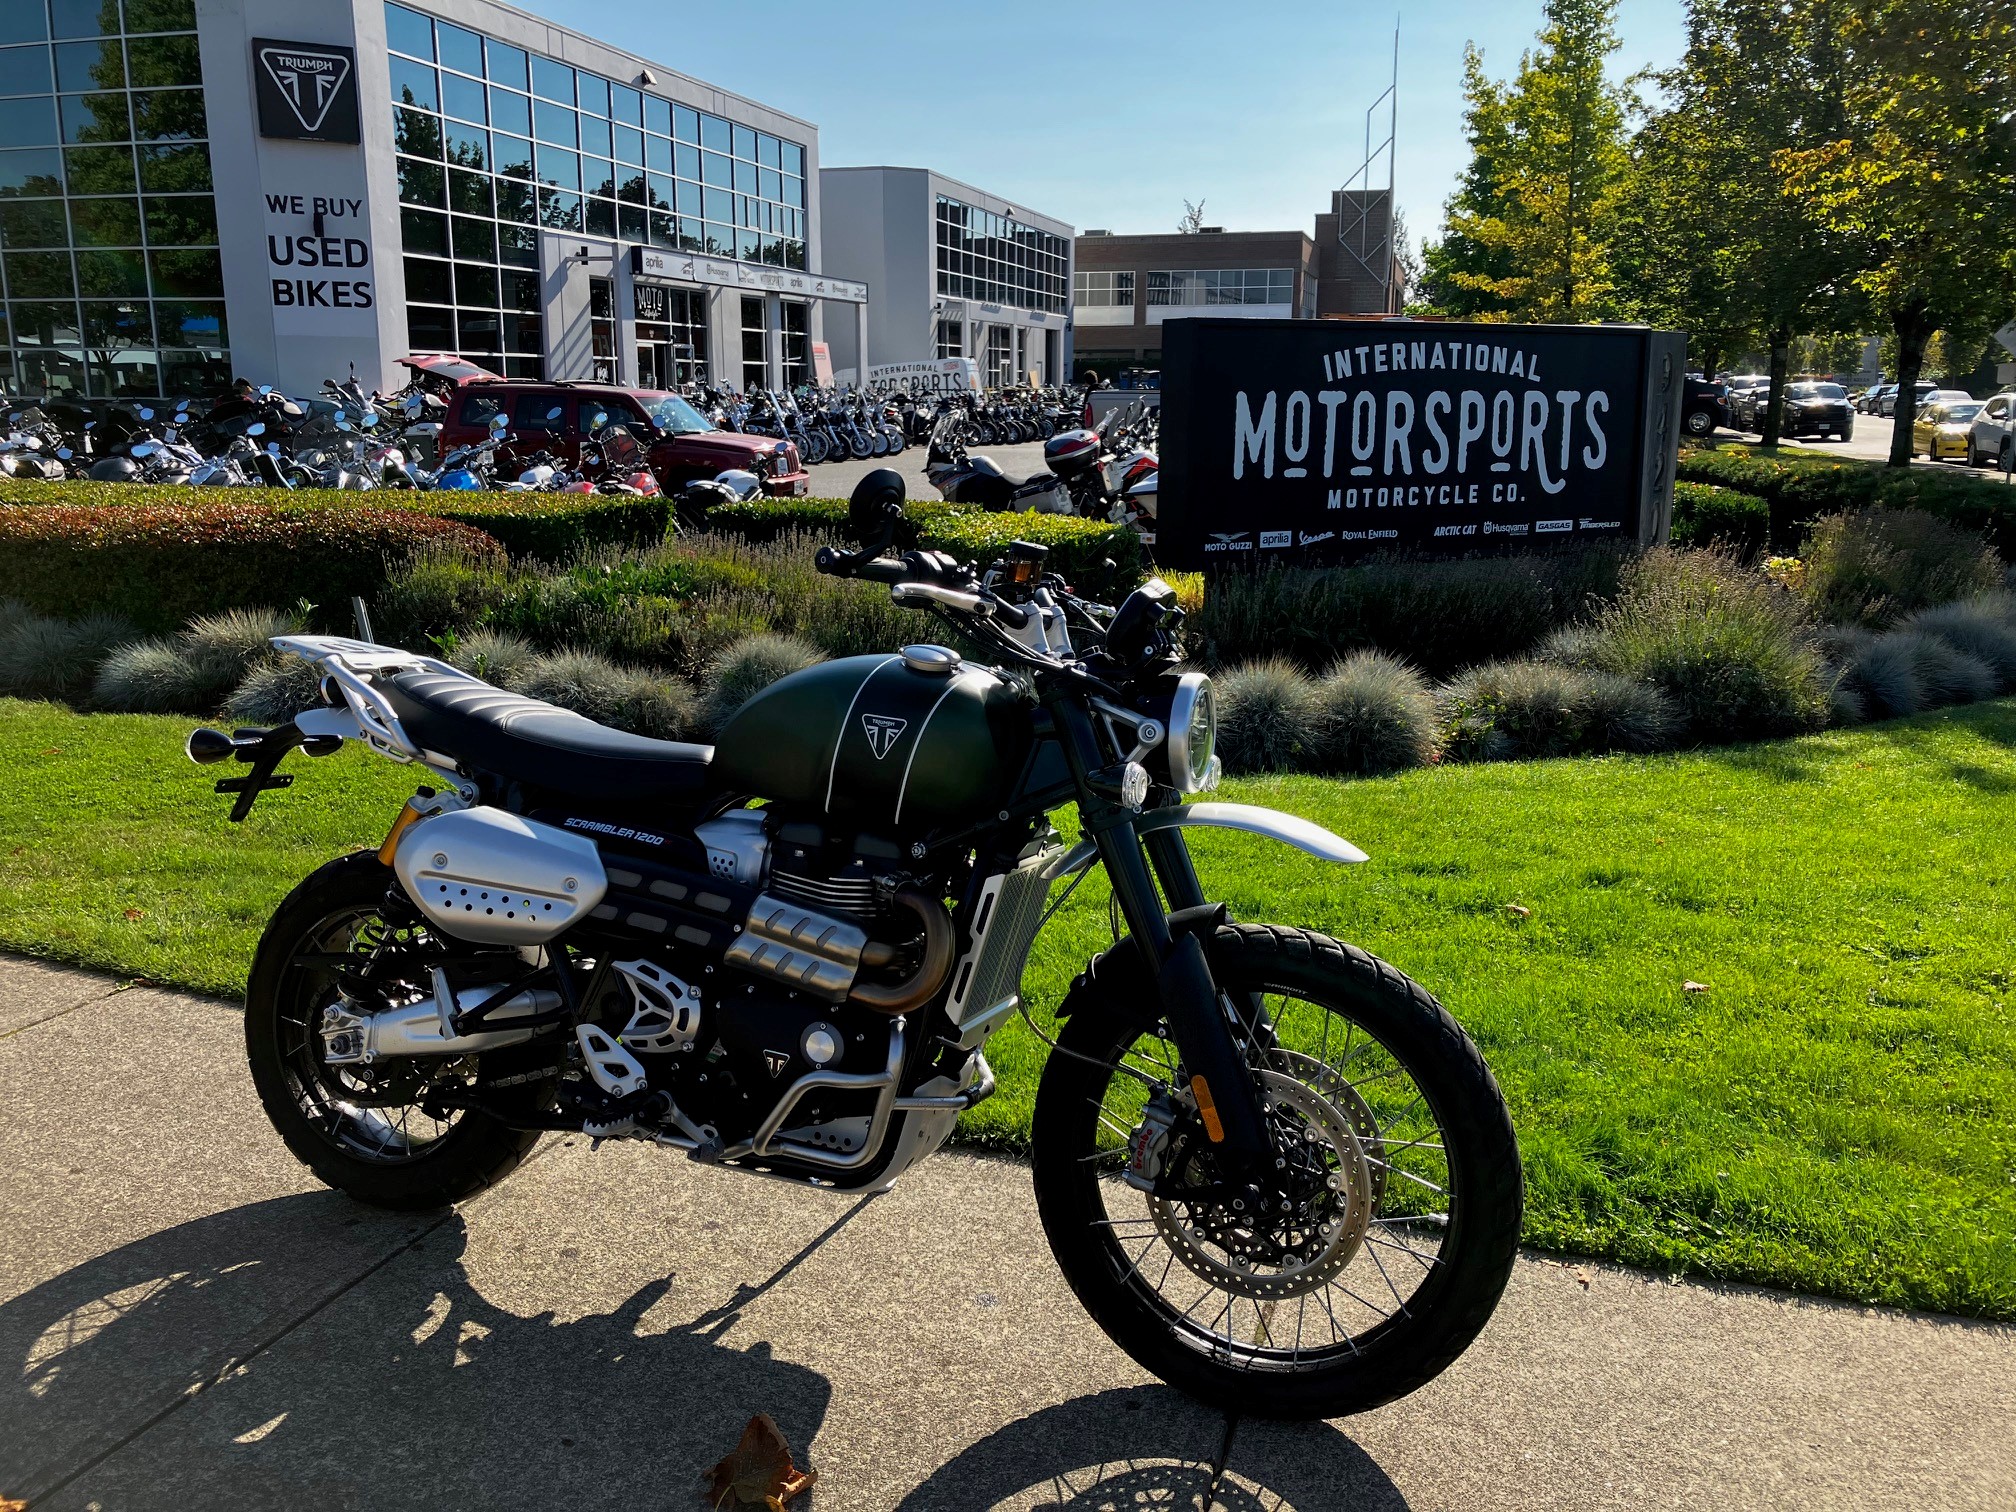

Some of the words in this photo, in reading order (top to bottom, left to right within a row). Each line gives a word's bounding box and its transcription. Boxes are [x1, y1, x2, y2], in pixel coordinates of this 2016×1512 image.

[277, 56, 333, 72] TRIUMPH
[265, 194, 305, 215] WE
[313, 197, 363, 218] BUY
[268, 235, 369, 268] USED
[272, 279, 373, 309] BIKES
[636, 286, 663, 311] MOTO
[1323, 342, 1541, 382] INTERNATIONAL
[870, 364, 939, 378] INTERNATIONAL
[1233, 390, 1610, 494] MOTORSPORTS
[1327, 484, 1478, 509] MOTORCYCLE
[1492, 483, 1526, 502] CO.
[1433, 526, 1461, 536] ARCTIC
[1462, 524, 1478, 535] CAT
[1492, 522, 1529, 534] Husqvarna
[1538, 521, 1571, 530] GASGAS
[1262, 533, 1290, 546] aprilia
[1299, 530, 1336, 546] Vespa
[1342, 530, 1367, 540] ROYAL
[1368, 529, 1399, 539] ENFIELD
[1204, 543, 1227, 551] MOTO
[1229, 542, 1252, 550] GUZZI
[872, 718, 896, 727] TRIUMPH
[564, 817, 636, 839] SCRAMBLER
[634, 831, 665, 846] 1200
[1134, 1128, 1153, 1170] brembo
